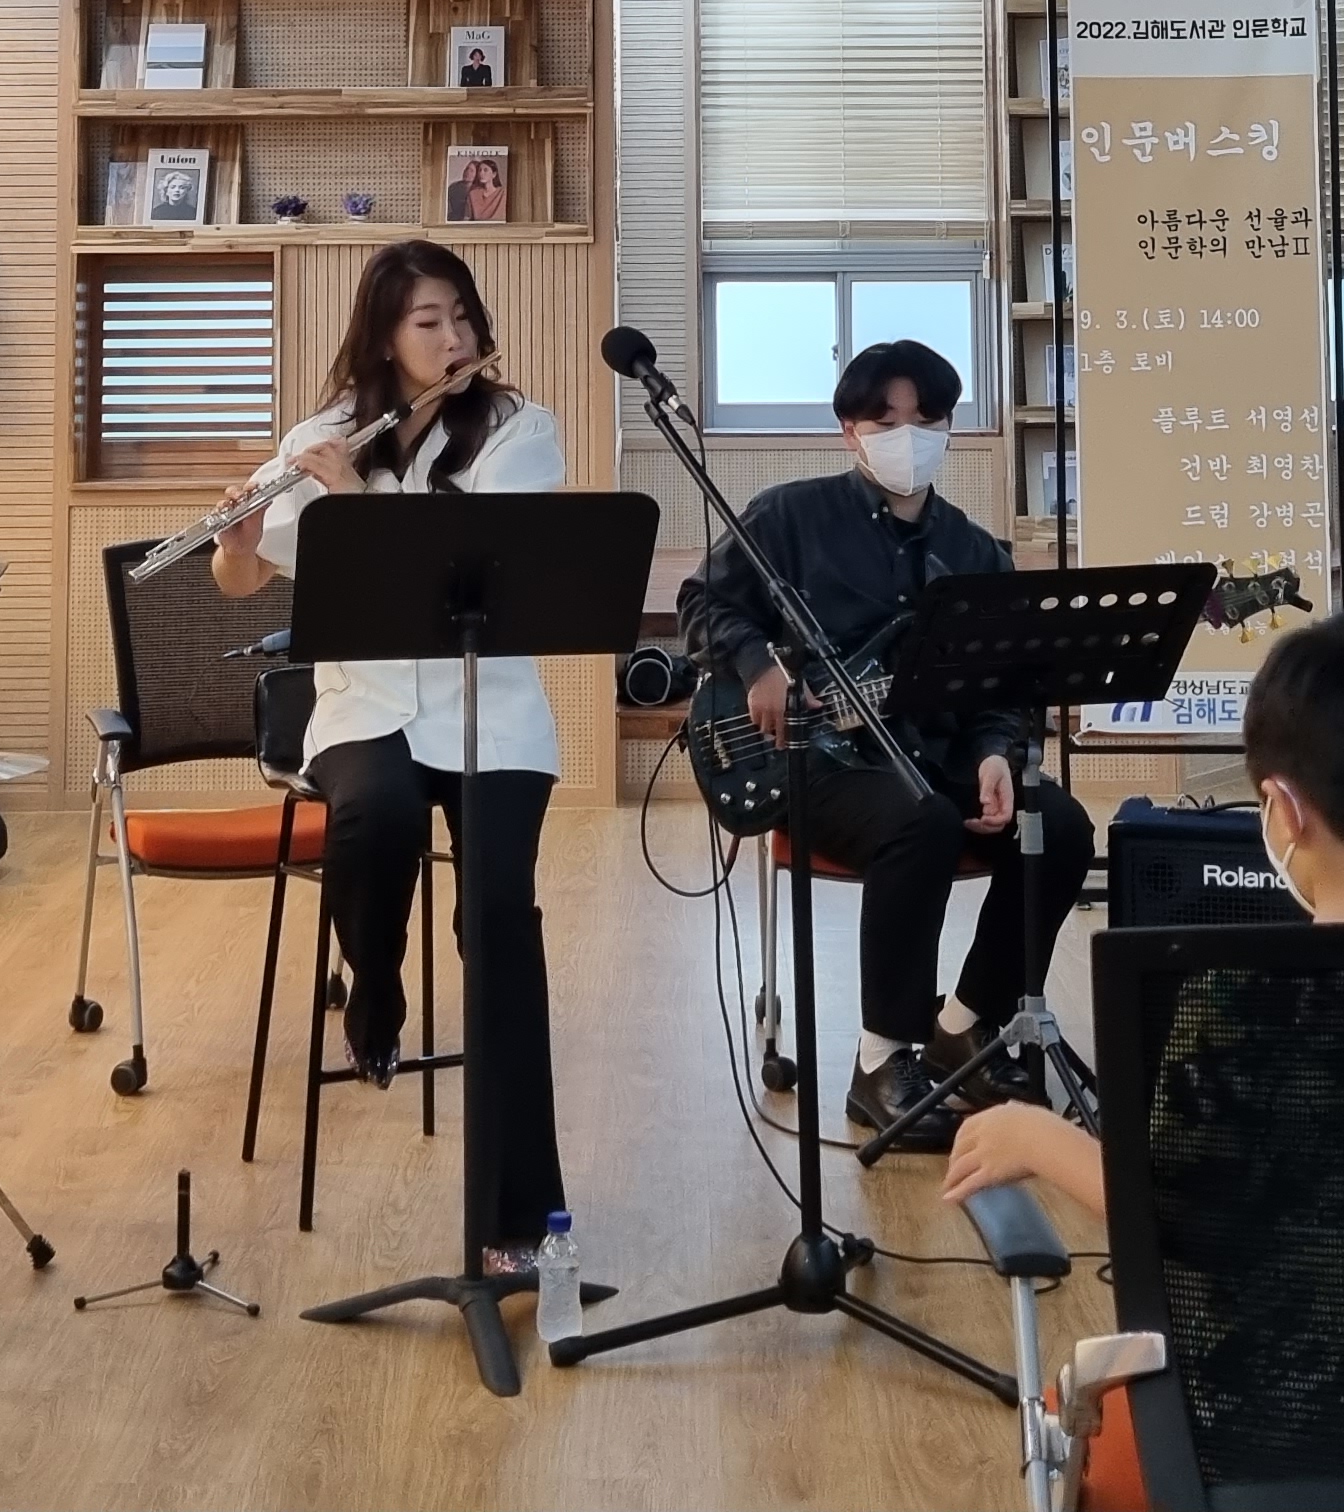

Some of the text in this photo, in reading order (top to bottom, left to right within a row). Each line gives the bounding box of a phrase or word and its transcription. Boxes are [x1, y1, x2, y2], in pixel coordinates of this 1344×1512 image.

[1076, 17, 1308, 39] 2022.김해도서관 인문학교
[1081, 119, 1279, 163] 인문버스킹
[1137, 207, 1313, 232] 아름다운 선율과
[1138, 235, 1228, 259] 인문학의
[1199, 308, 1260, 329] 14:00
[1080, 350, 1174, 374] 1층 로비
[1151, 405, 1320, 434] 플루트 서영선
[1179, 453, 1324, 481] 건반 최영찬
[1181, 501, 1230, 529] 드럼
